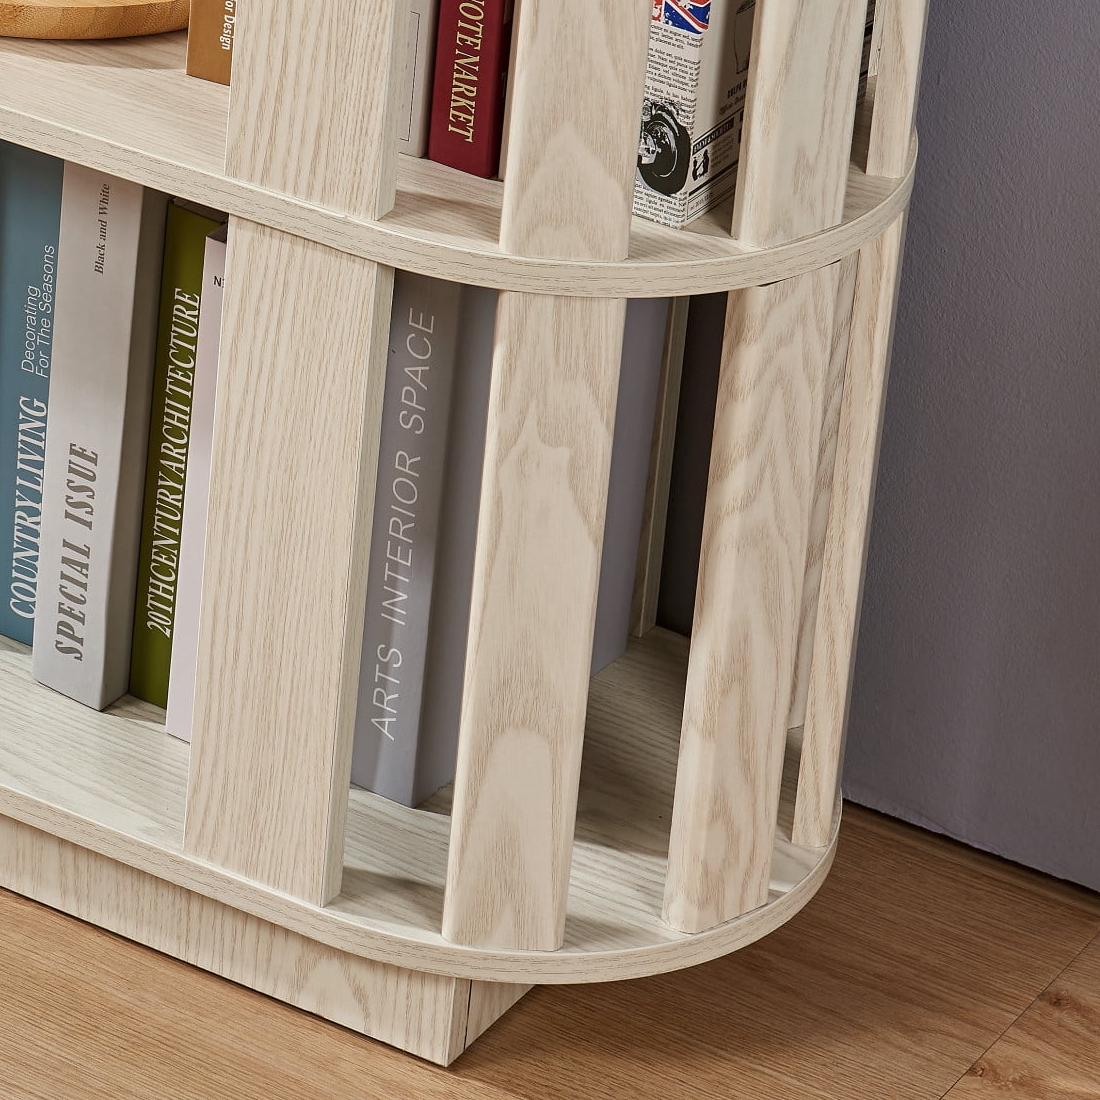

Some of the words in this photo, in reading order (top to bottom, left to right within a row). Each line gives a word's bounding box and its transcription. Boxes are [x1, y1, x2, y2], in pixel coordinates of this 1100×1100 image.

[219, 14, 236, 51] Design
[448, 49, 481, 143] NARKET
[98, 183, 111, 217] White
[98, 218, 109, 242] and
[39, 244, 56, 314] Seasons
[94, 241, 105, 275] Black
[20, 285, 41, 374] Decorating
[35, 346, 50, 379] For
[38, 313, 52, 345] The
[398, 306, 435, 435] SPACE
[16, 395, 48, 494] LIVING
[64, 442, 100, 532] ISSUE
[8, 490, 43, 620] COUNTRY
[381, 450, 421, 627] INTERIOR
[54, 538, 92, 662] SPECIAL
[371, 644, 403, 742] ARTS
